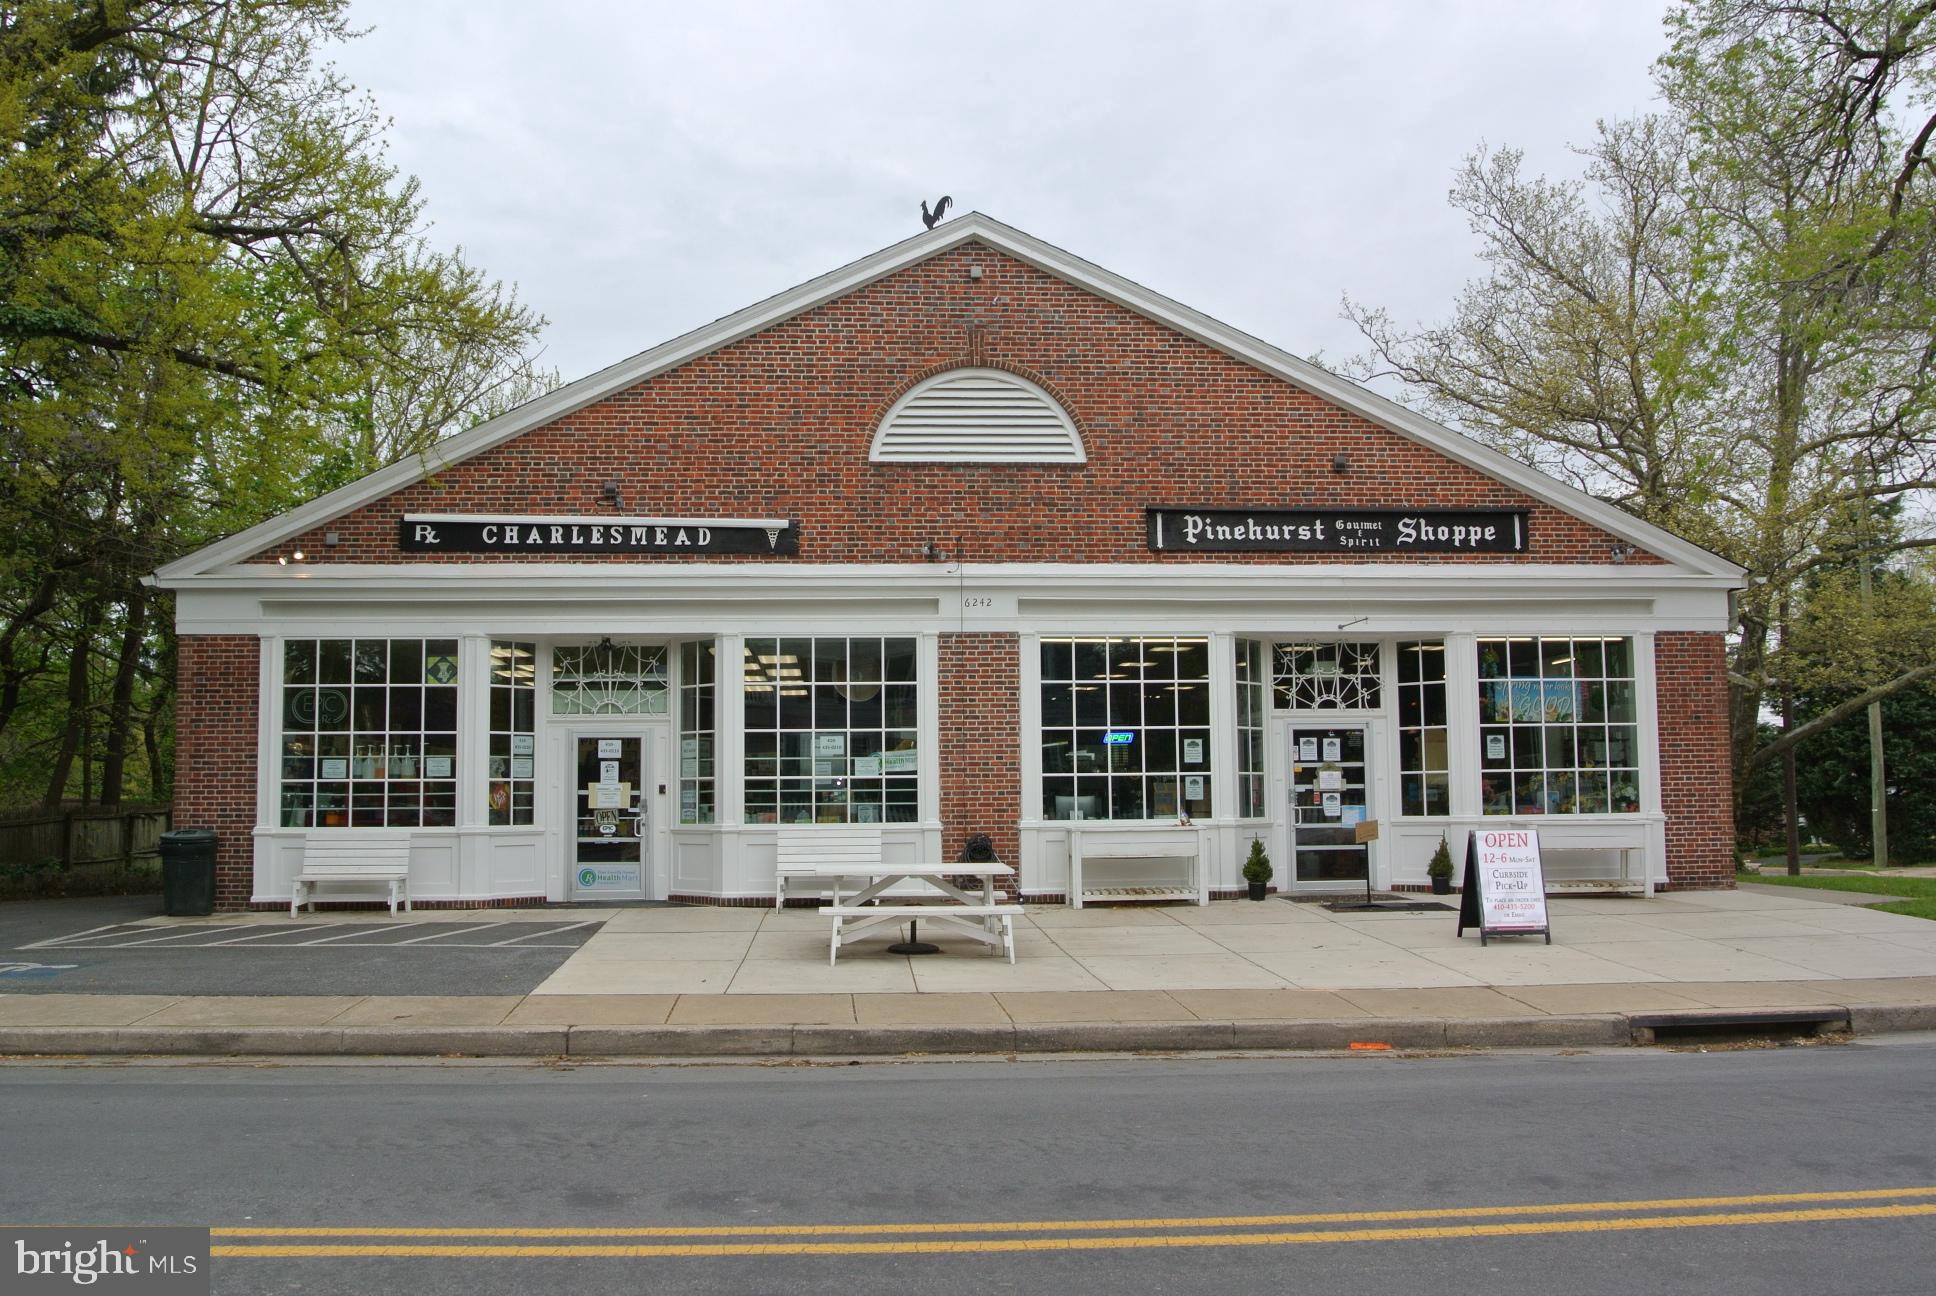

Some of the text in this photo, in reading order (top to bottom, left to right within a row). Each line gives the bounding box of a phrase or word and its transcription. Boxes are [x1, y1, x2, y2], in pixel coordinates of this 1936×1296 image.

[1183, 515, 1496, 547] Pinehurst Shoppe
[1335, 519, 1382, 531] Gourmet
[482, 525, 711, 546] CHARLESMEAD
[1340, 536, 1380, 547] Spirit
[964, 597, 992, 608] 6242
[303, 695, 337, 712] EPIC
[1106, 733, 1131, 742] OPEN
[595, 810, 618, 825] OPEN
[1484, 832, 1529, 848] OPEN
[1483, 853, 1507, 864] 12-6
[597, 873, 621, 881] Health
